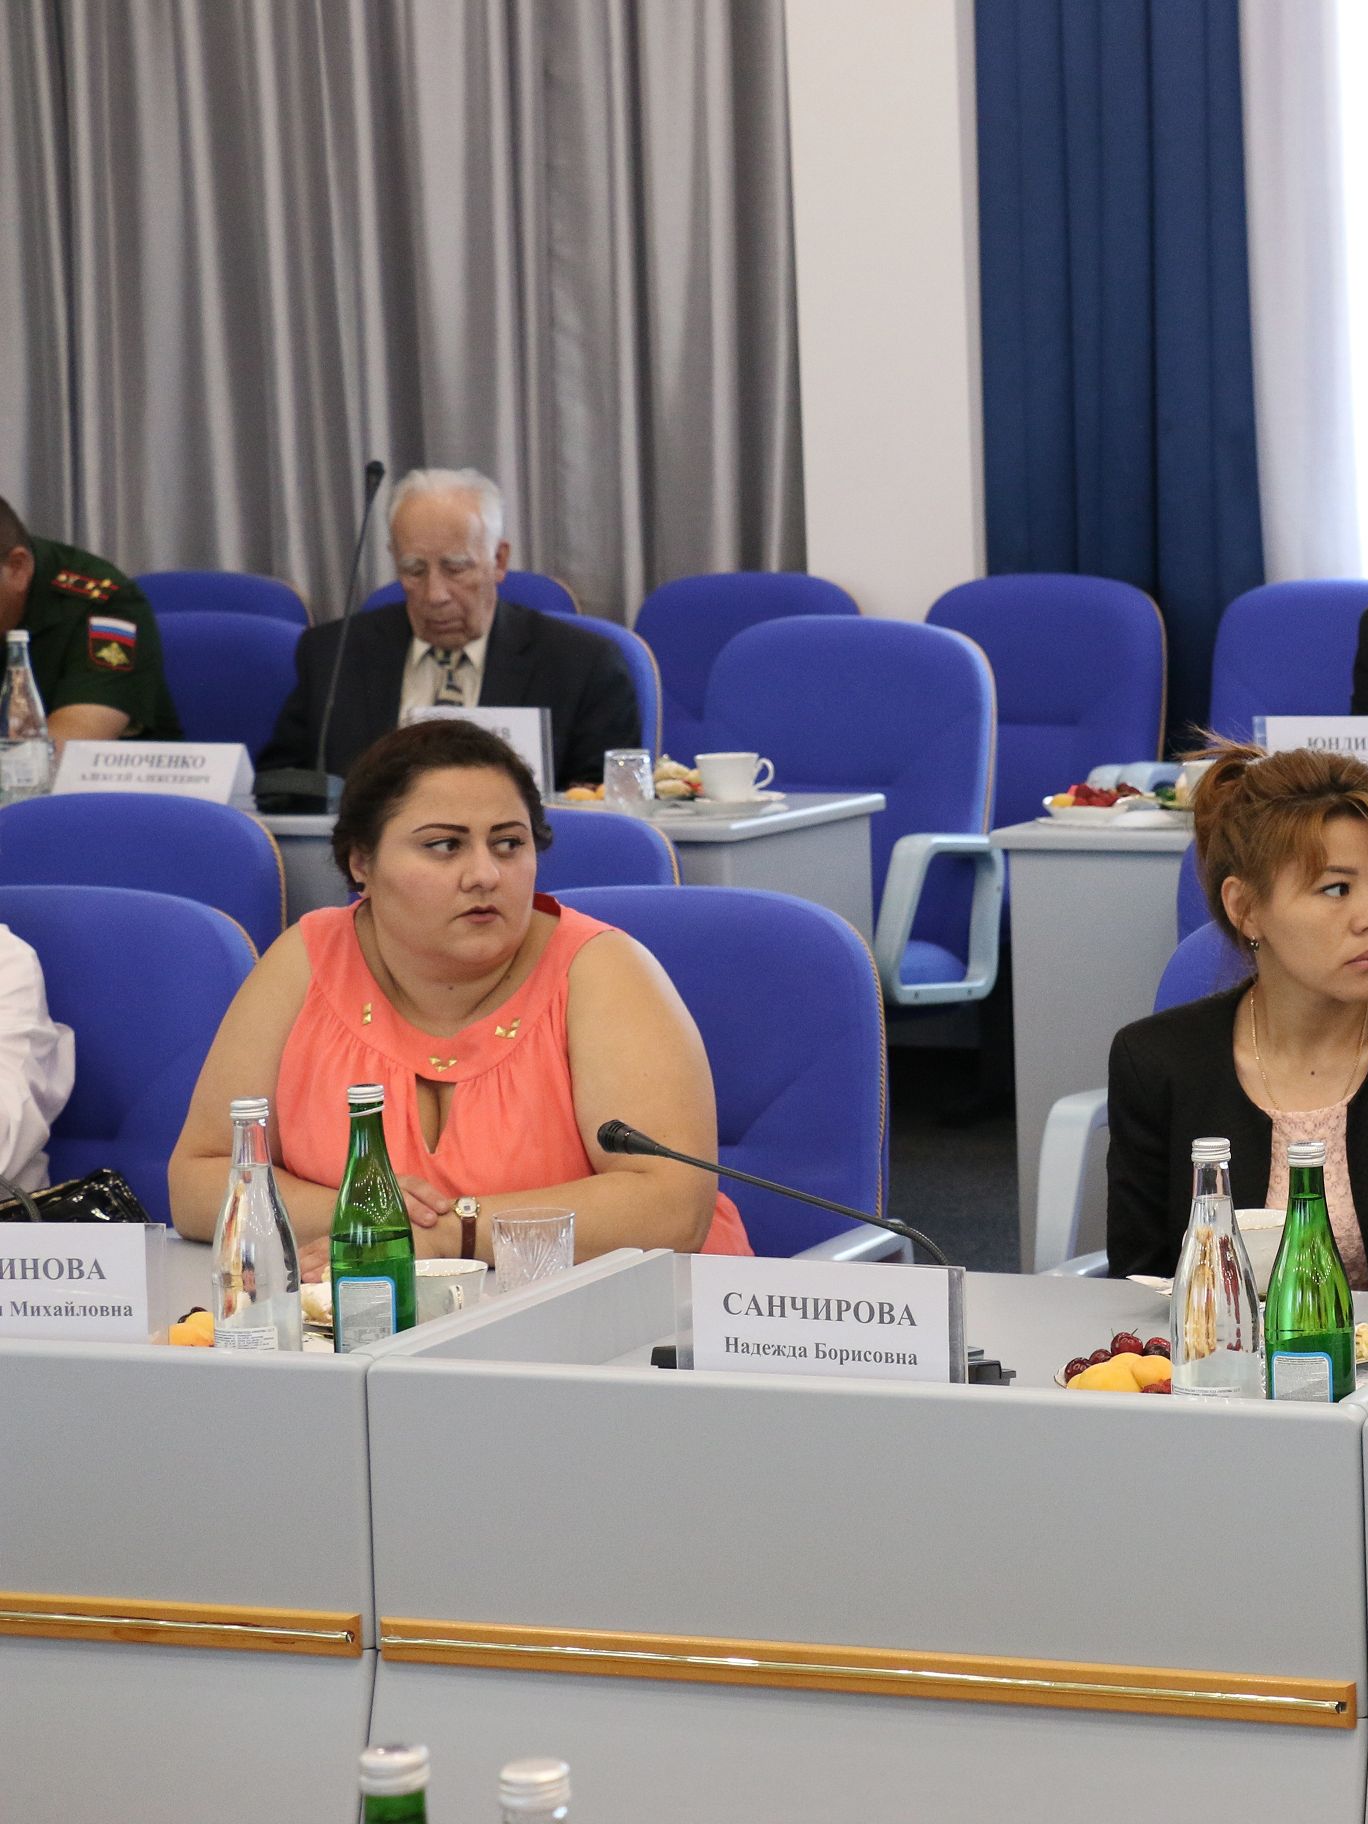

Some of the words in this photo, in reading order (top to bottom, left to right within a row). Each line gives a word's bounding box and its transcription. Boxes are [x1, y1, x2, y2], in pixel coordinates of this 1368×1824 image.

[0, 1257, 107, 1281] ИНОВА
[10, 1300, 134, 1317] Михайловна
[722, 1291, 918, 1327] САНЧИРОВА
[724, 1336, 808, 1359] Надежда
[814, 1342, 918, 1366] Борисовна
